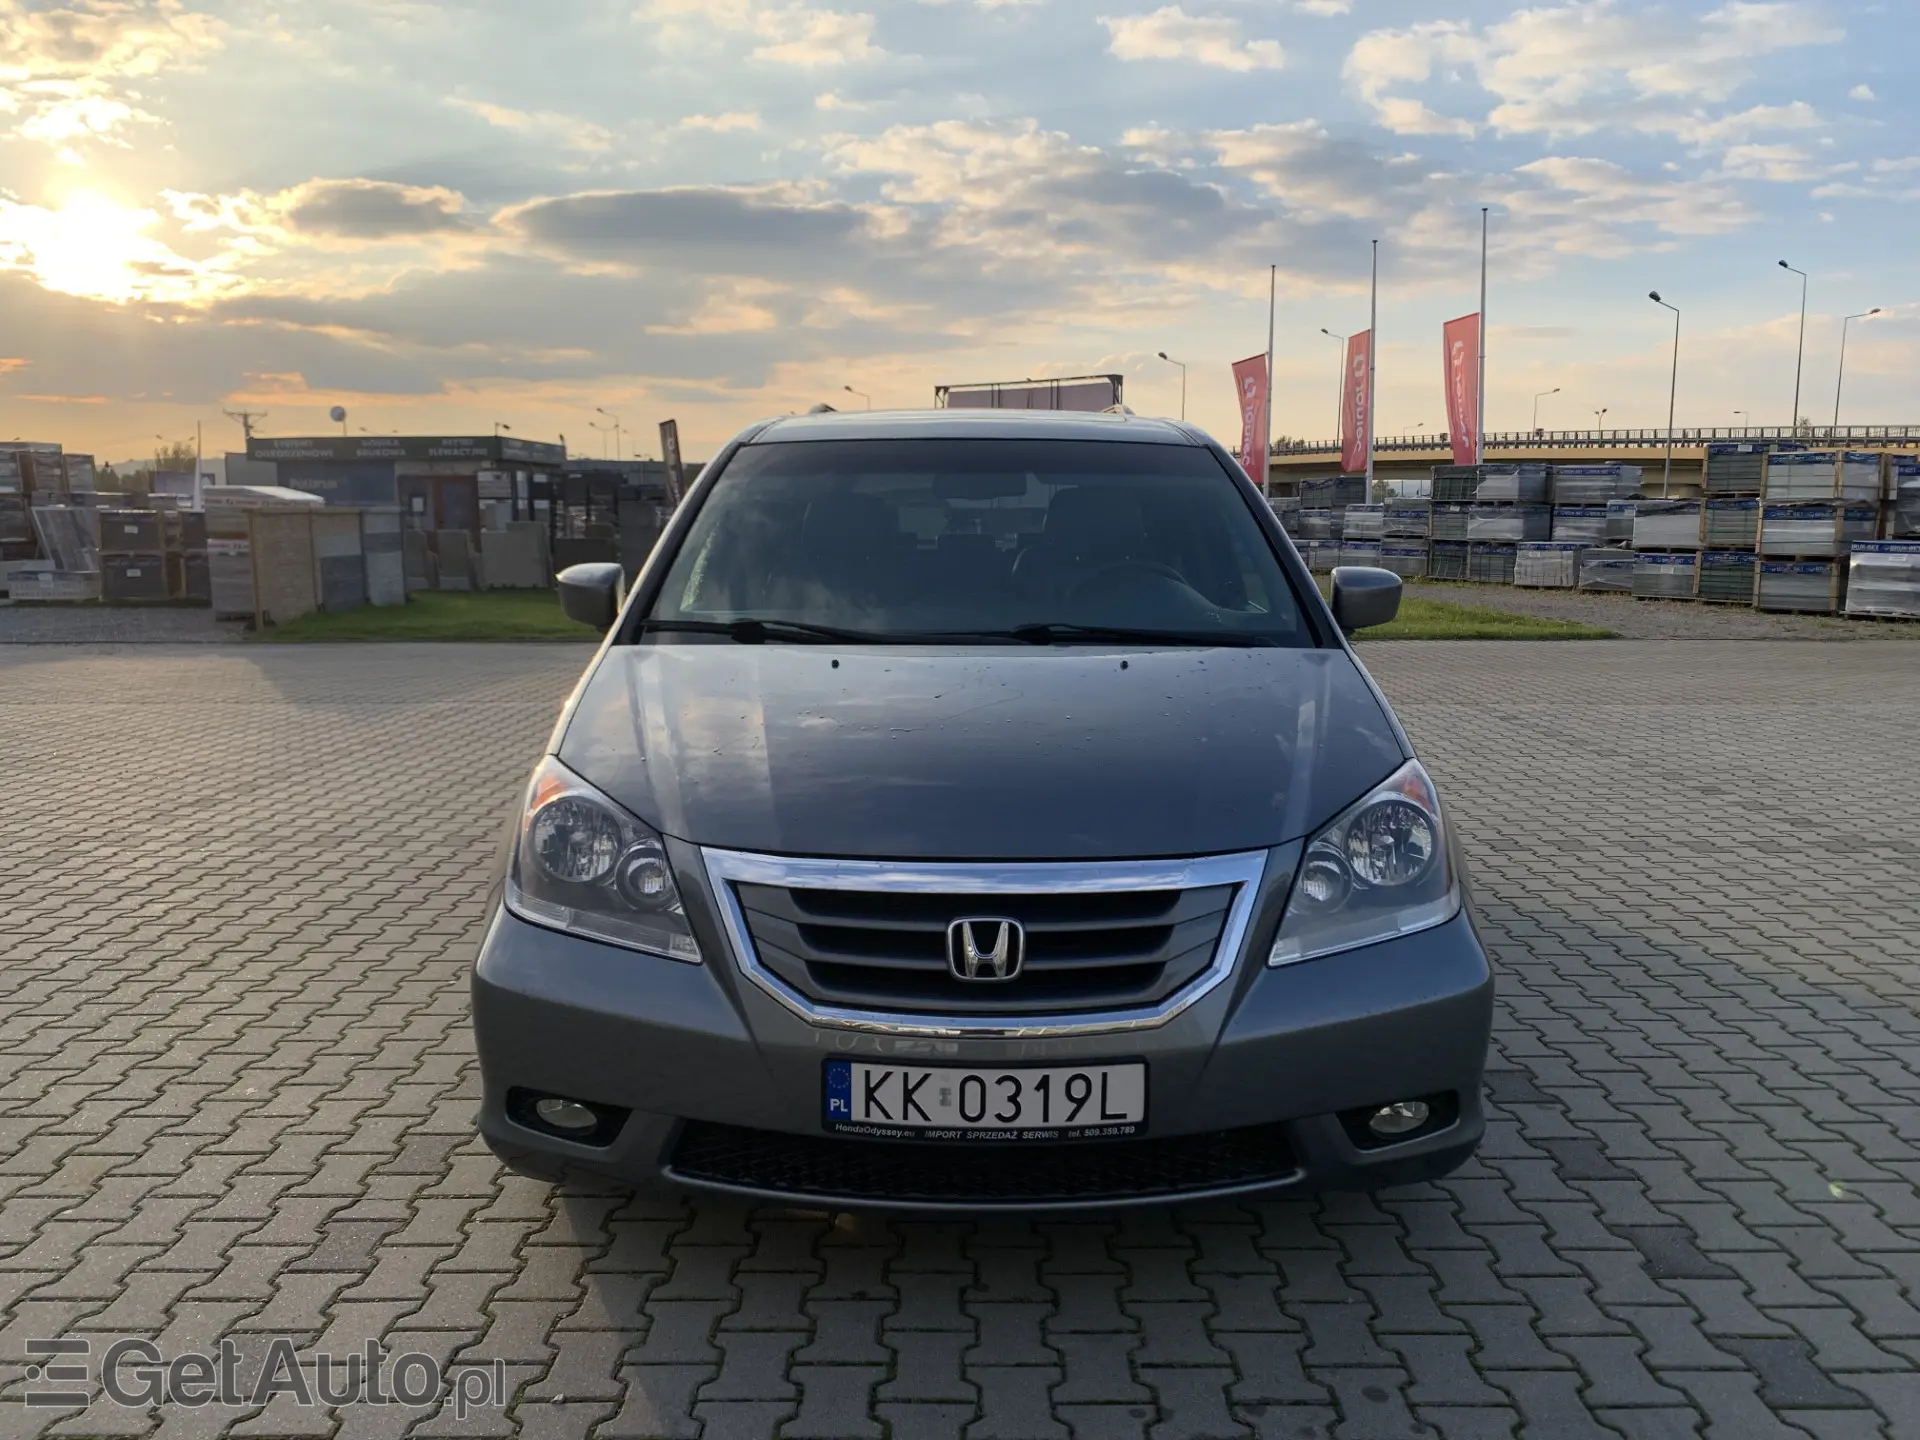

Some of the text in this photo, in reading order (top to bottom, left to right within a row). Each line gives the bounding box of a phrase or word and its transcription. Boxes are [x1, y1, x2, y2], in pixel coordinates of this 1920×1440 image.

[863, 1069, 1128, 1123] KK 0319L
[829, 1098, 849, 1113] PL
[835, 1123, 916, 1138] HondaOdyssey.eu
[924, 1129, 962, 1139] IMPORT
[966, 1129, 1018, 1140] SPRZEDAŻ
[1022, 1130, 1060, 1139] SERWIS
[1068, 1129, 1081, 1138] tel.
